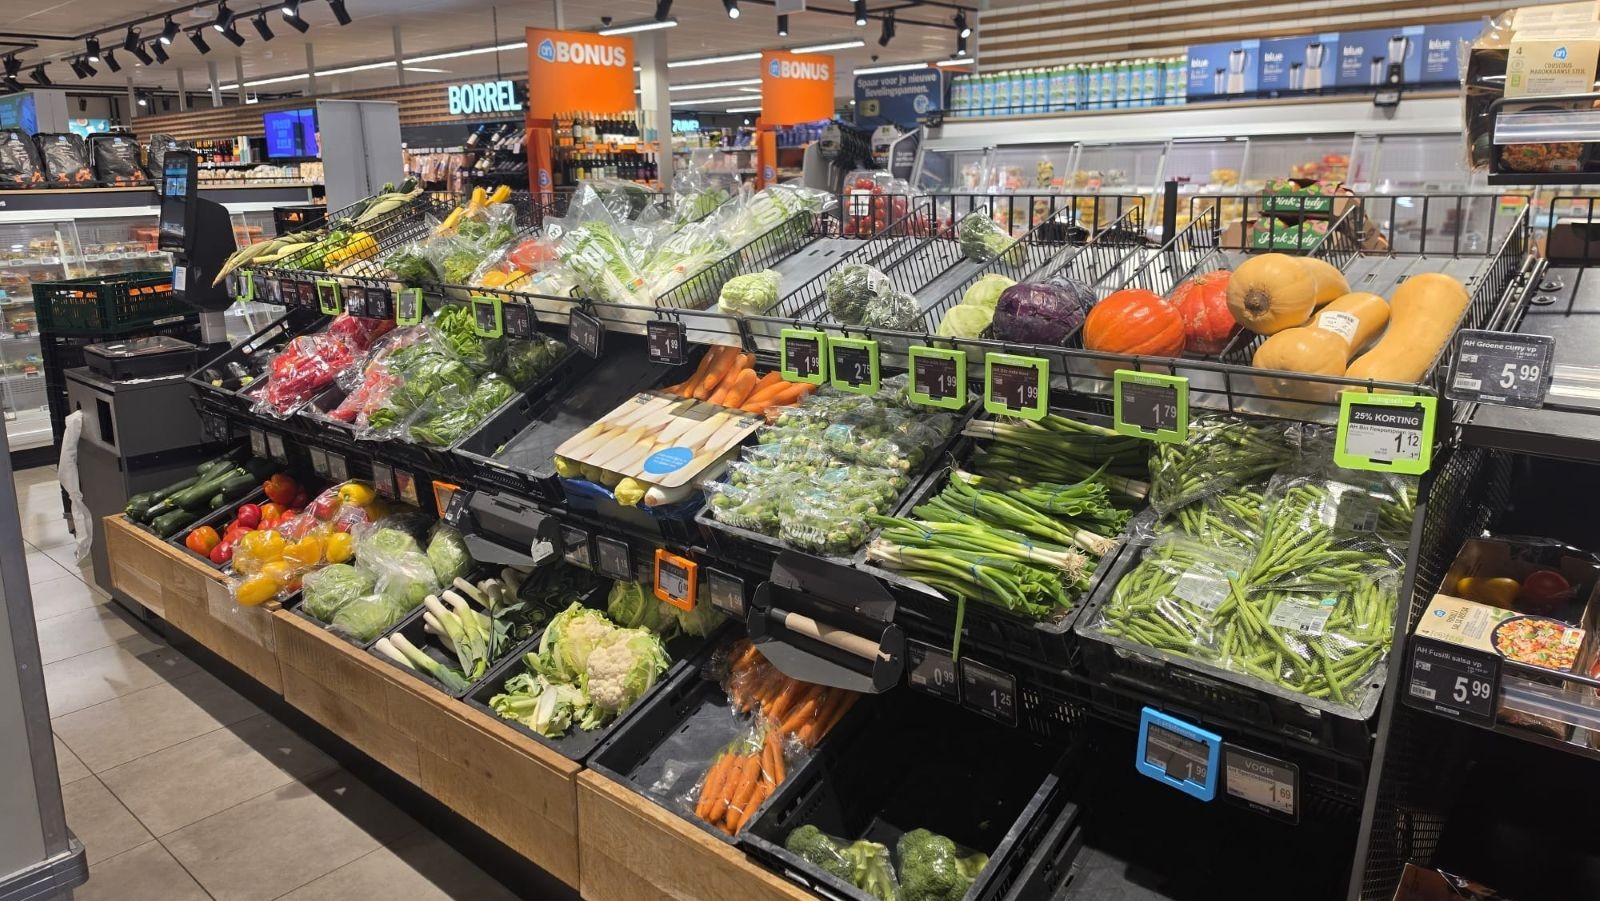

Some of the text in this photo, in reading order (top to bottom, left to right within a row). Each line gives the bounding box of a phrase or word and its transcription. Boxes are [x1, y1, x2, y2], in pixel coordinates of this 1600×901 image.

[556, 41, 626, 67] BONUS
[1343, 46, 1364, 56] blue
[1428, 39, 1451, 50] blue
[1191, 58, 1209, 68] blue
[1264, 52, 1284, 62] blue
[781, 61, 829, 80] BONUS
[858, 73, 937, 88] Spaar voor je nieuwe
[448, 80, 522, 115] BORREL
[865, 86, 928, 97] lievelingspannen.
[1476, 341, 1504, 350] Groene
[1504, 344, 1525, 353] curry
[854, 362, 871, 380] 2.75
[1500, 363, 1540, 389] 5.99
[938, 374, 957, 392] 1.99
[1017, 385, 1038, 405] 1.99
[1152, 403, 1177, 425] 1.79
[1354, 411, 1419, 426] 25% KORTING
[1394, 433, 1419, 453] 1.12
[1416, 646, 1427, 654] AH
[1428, 648, 1450, 659] Fusilli
[1452, 656, 1471, 665] salsa
[934, 668, 954, 687] 0.99
[990, 689, 1011, 710] 1.25
[1453, 676, 1490, 704] 5.99
[1244, 761, 1274, 776] VOOR
[1269, 784, 1291, 803] 1.69
